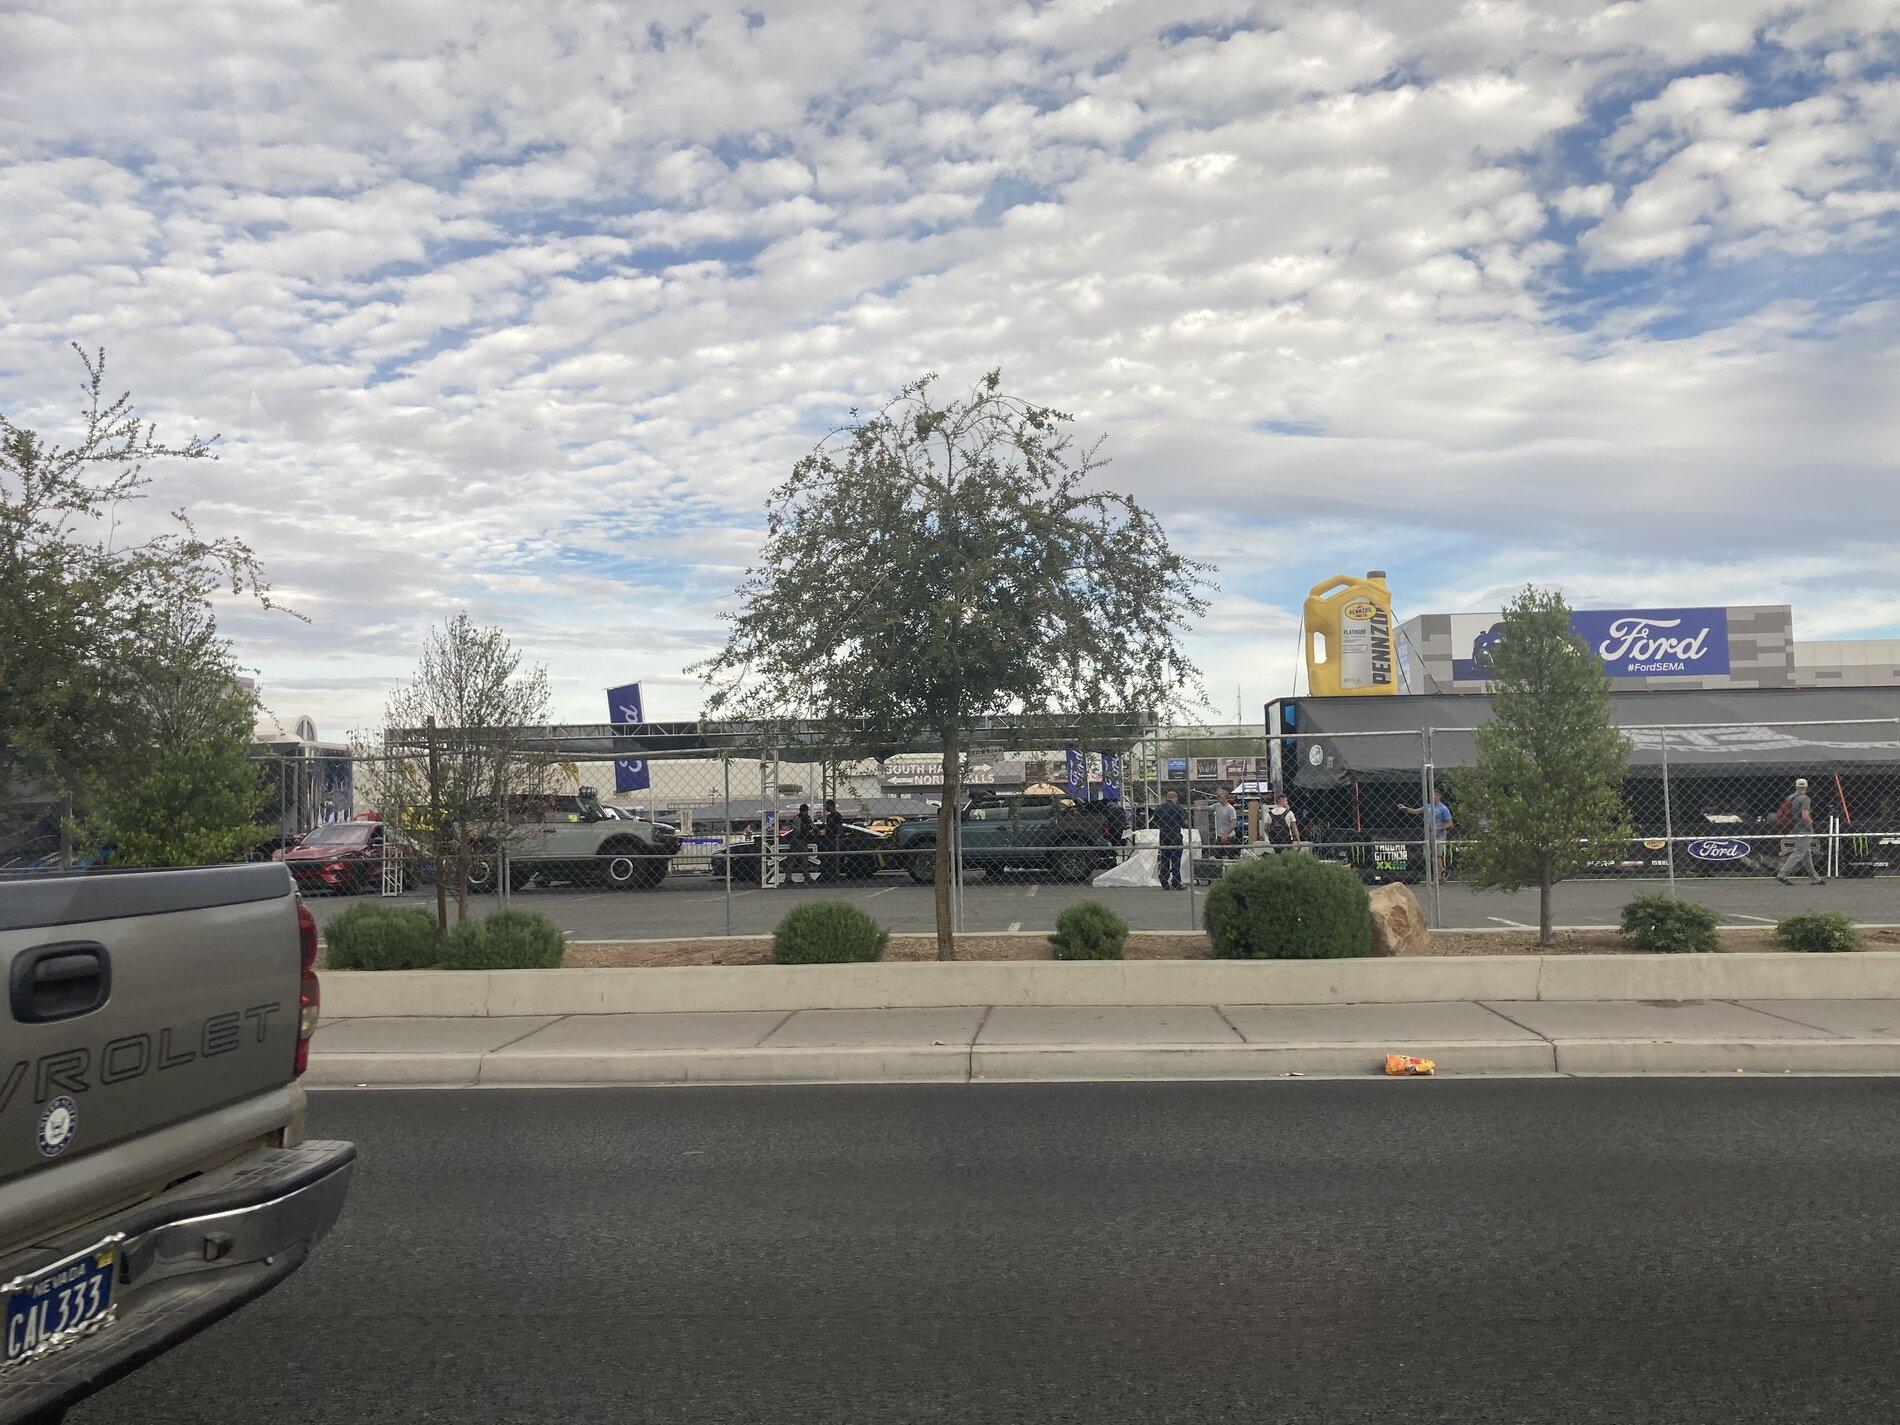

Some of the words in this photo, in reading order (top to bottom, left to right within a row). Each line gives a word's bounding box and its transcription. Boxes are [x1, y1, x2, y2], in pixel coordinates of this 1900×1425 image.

[1369, 602, 1391, 685] PENNZO
[1600, 617, 1709, 661] Ford
[1628, 662, 1685, 672] #FordSEMA
[885, 764, 925, 775] SOUTH
[914, 775, 945, 785] NORT
[959, 774, 995, 784] ALLS
[1700, 841, 1739, 857] Ford
[33, 1263, 86, 1299] NEVADA
